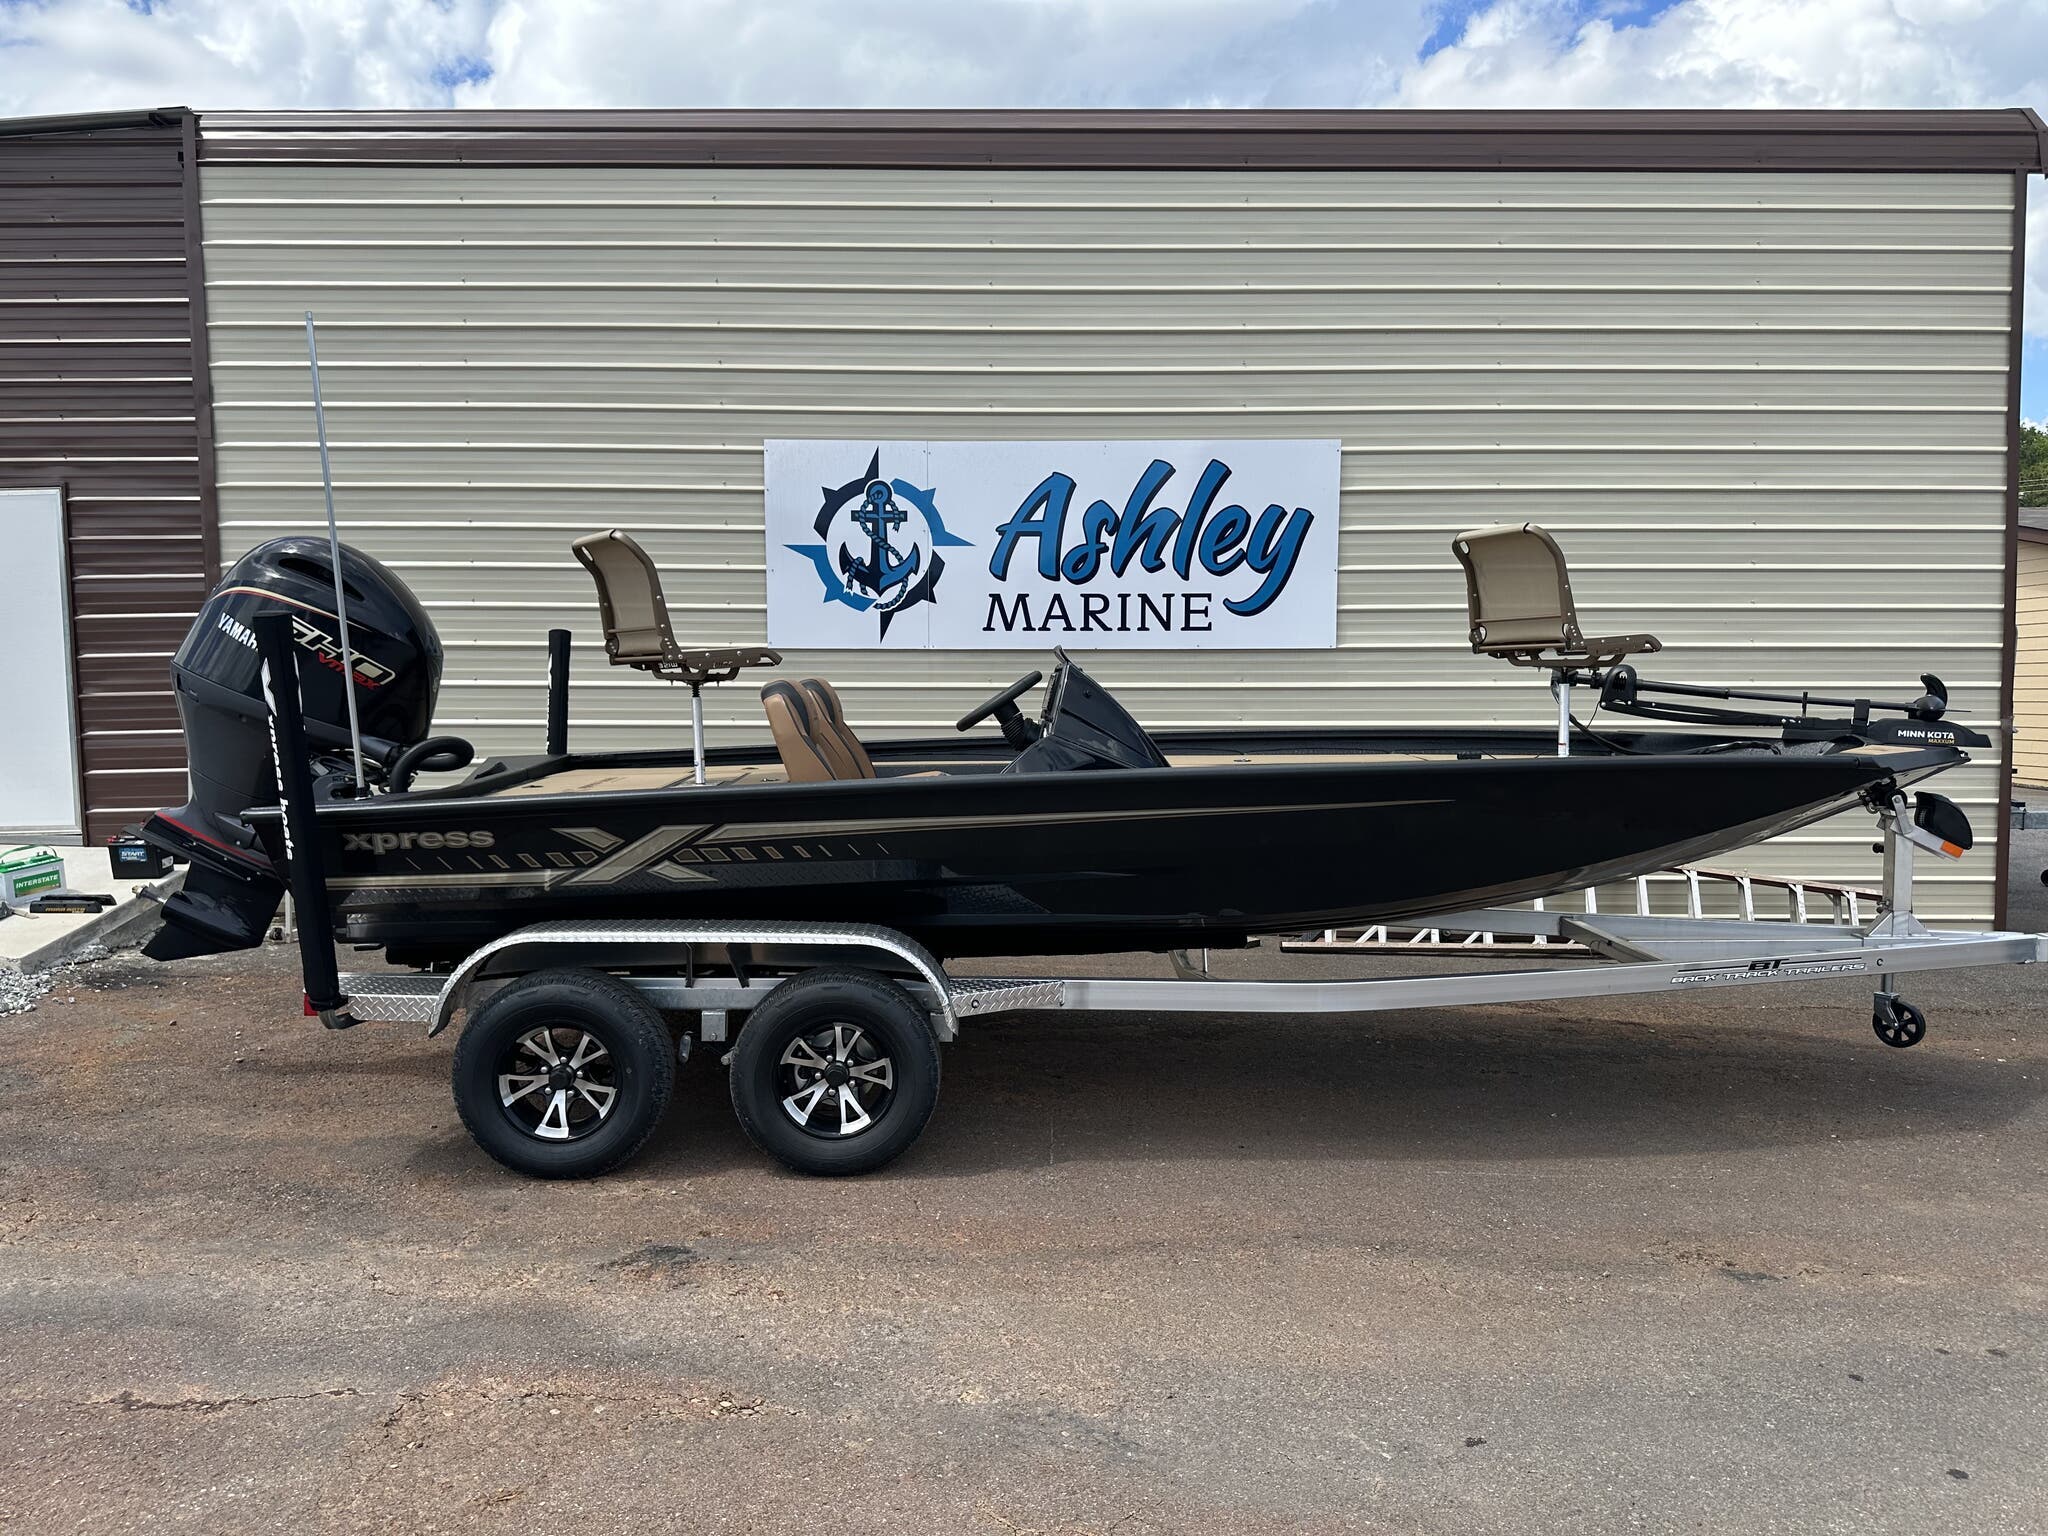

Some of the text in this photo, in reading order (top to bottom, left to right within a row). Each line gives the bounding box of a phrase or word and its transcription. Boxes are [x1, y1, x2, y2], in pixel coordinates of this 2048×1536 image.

[989, 459, 1315, 617] Ashley
[983, 593, 1213, 632] MARINE
[218, 612, 259, 652] YAMAH
[1897, 730, 1955, 739] MINN KOTA
[342, 830, 496, 855] xpress
[15, 874, 59, 889] INTERSTATE
[1670, 962, 1866, 984] BACK TRACK TRAILERS
[1748, 958, 1790, 971] BT
